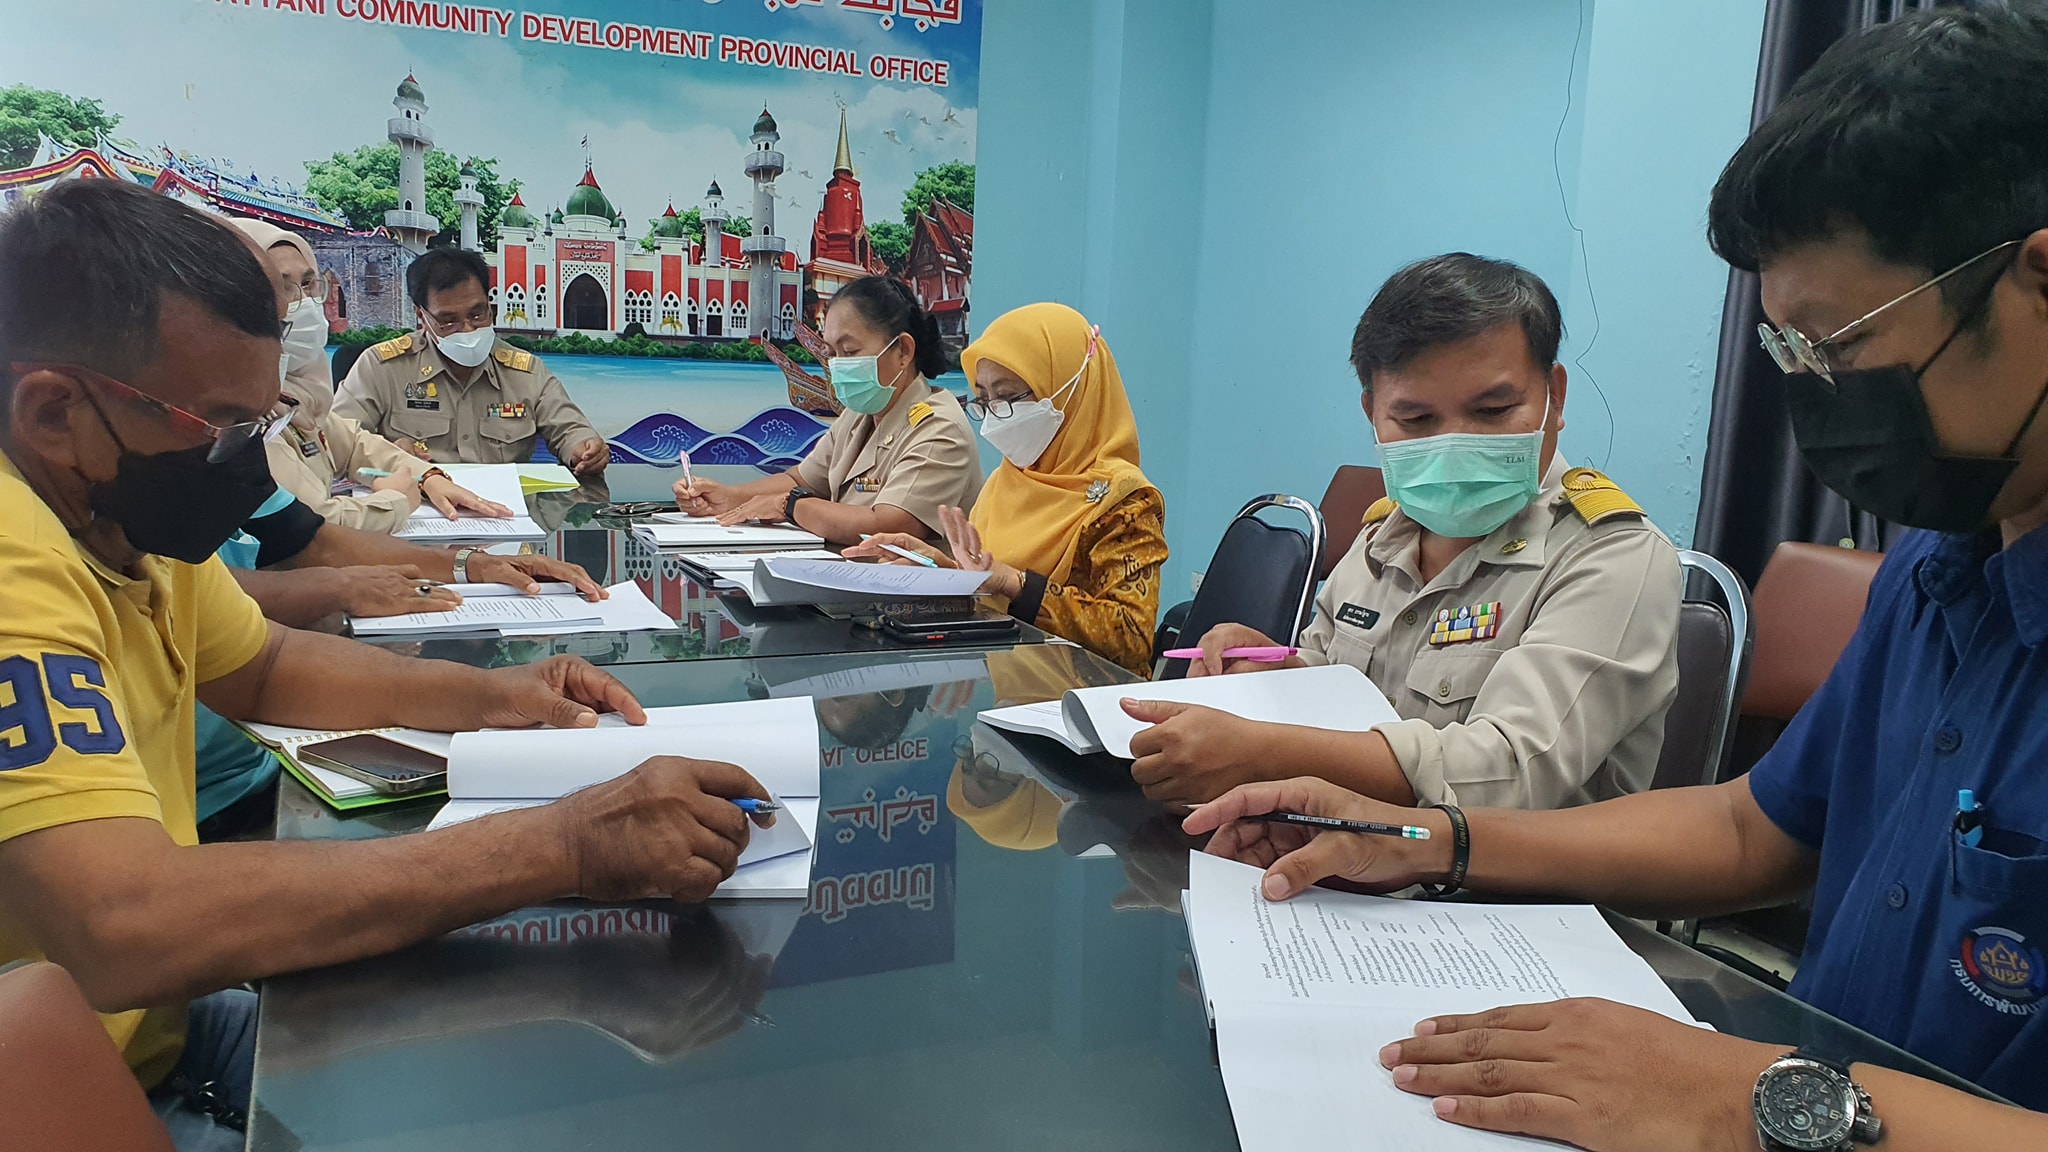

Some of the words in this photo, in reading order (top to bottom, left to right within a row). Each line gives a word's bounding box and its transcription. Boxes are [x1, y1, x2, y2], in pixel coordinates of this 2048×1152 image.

[337, 0, 512, 35] COMMUNITY
[523, 15, 712, 57] DEVELOPMENT
[721, 37, 862, 75] PROVINCIAL
[870, 56, 948, 85] OFFICE
[0, 652, 126, 771] 95
